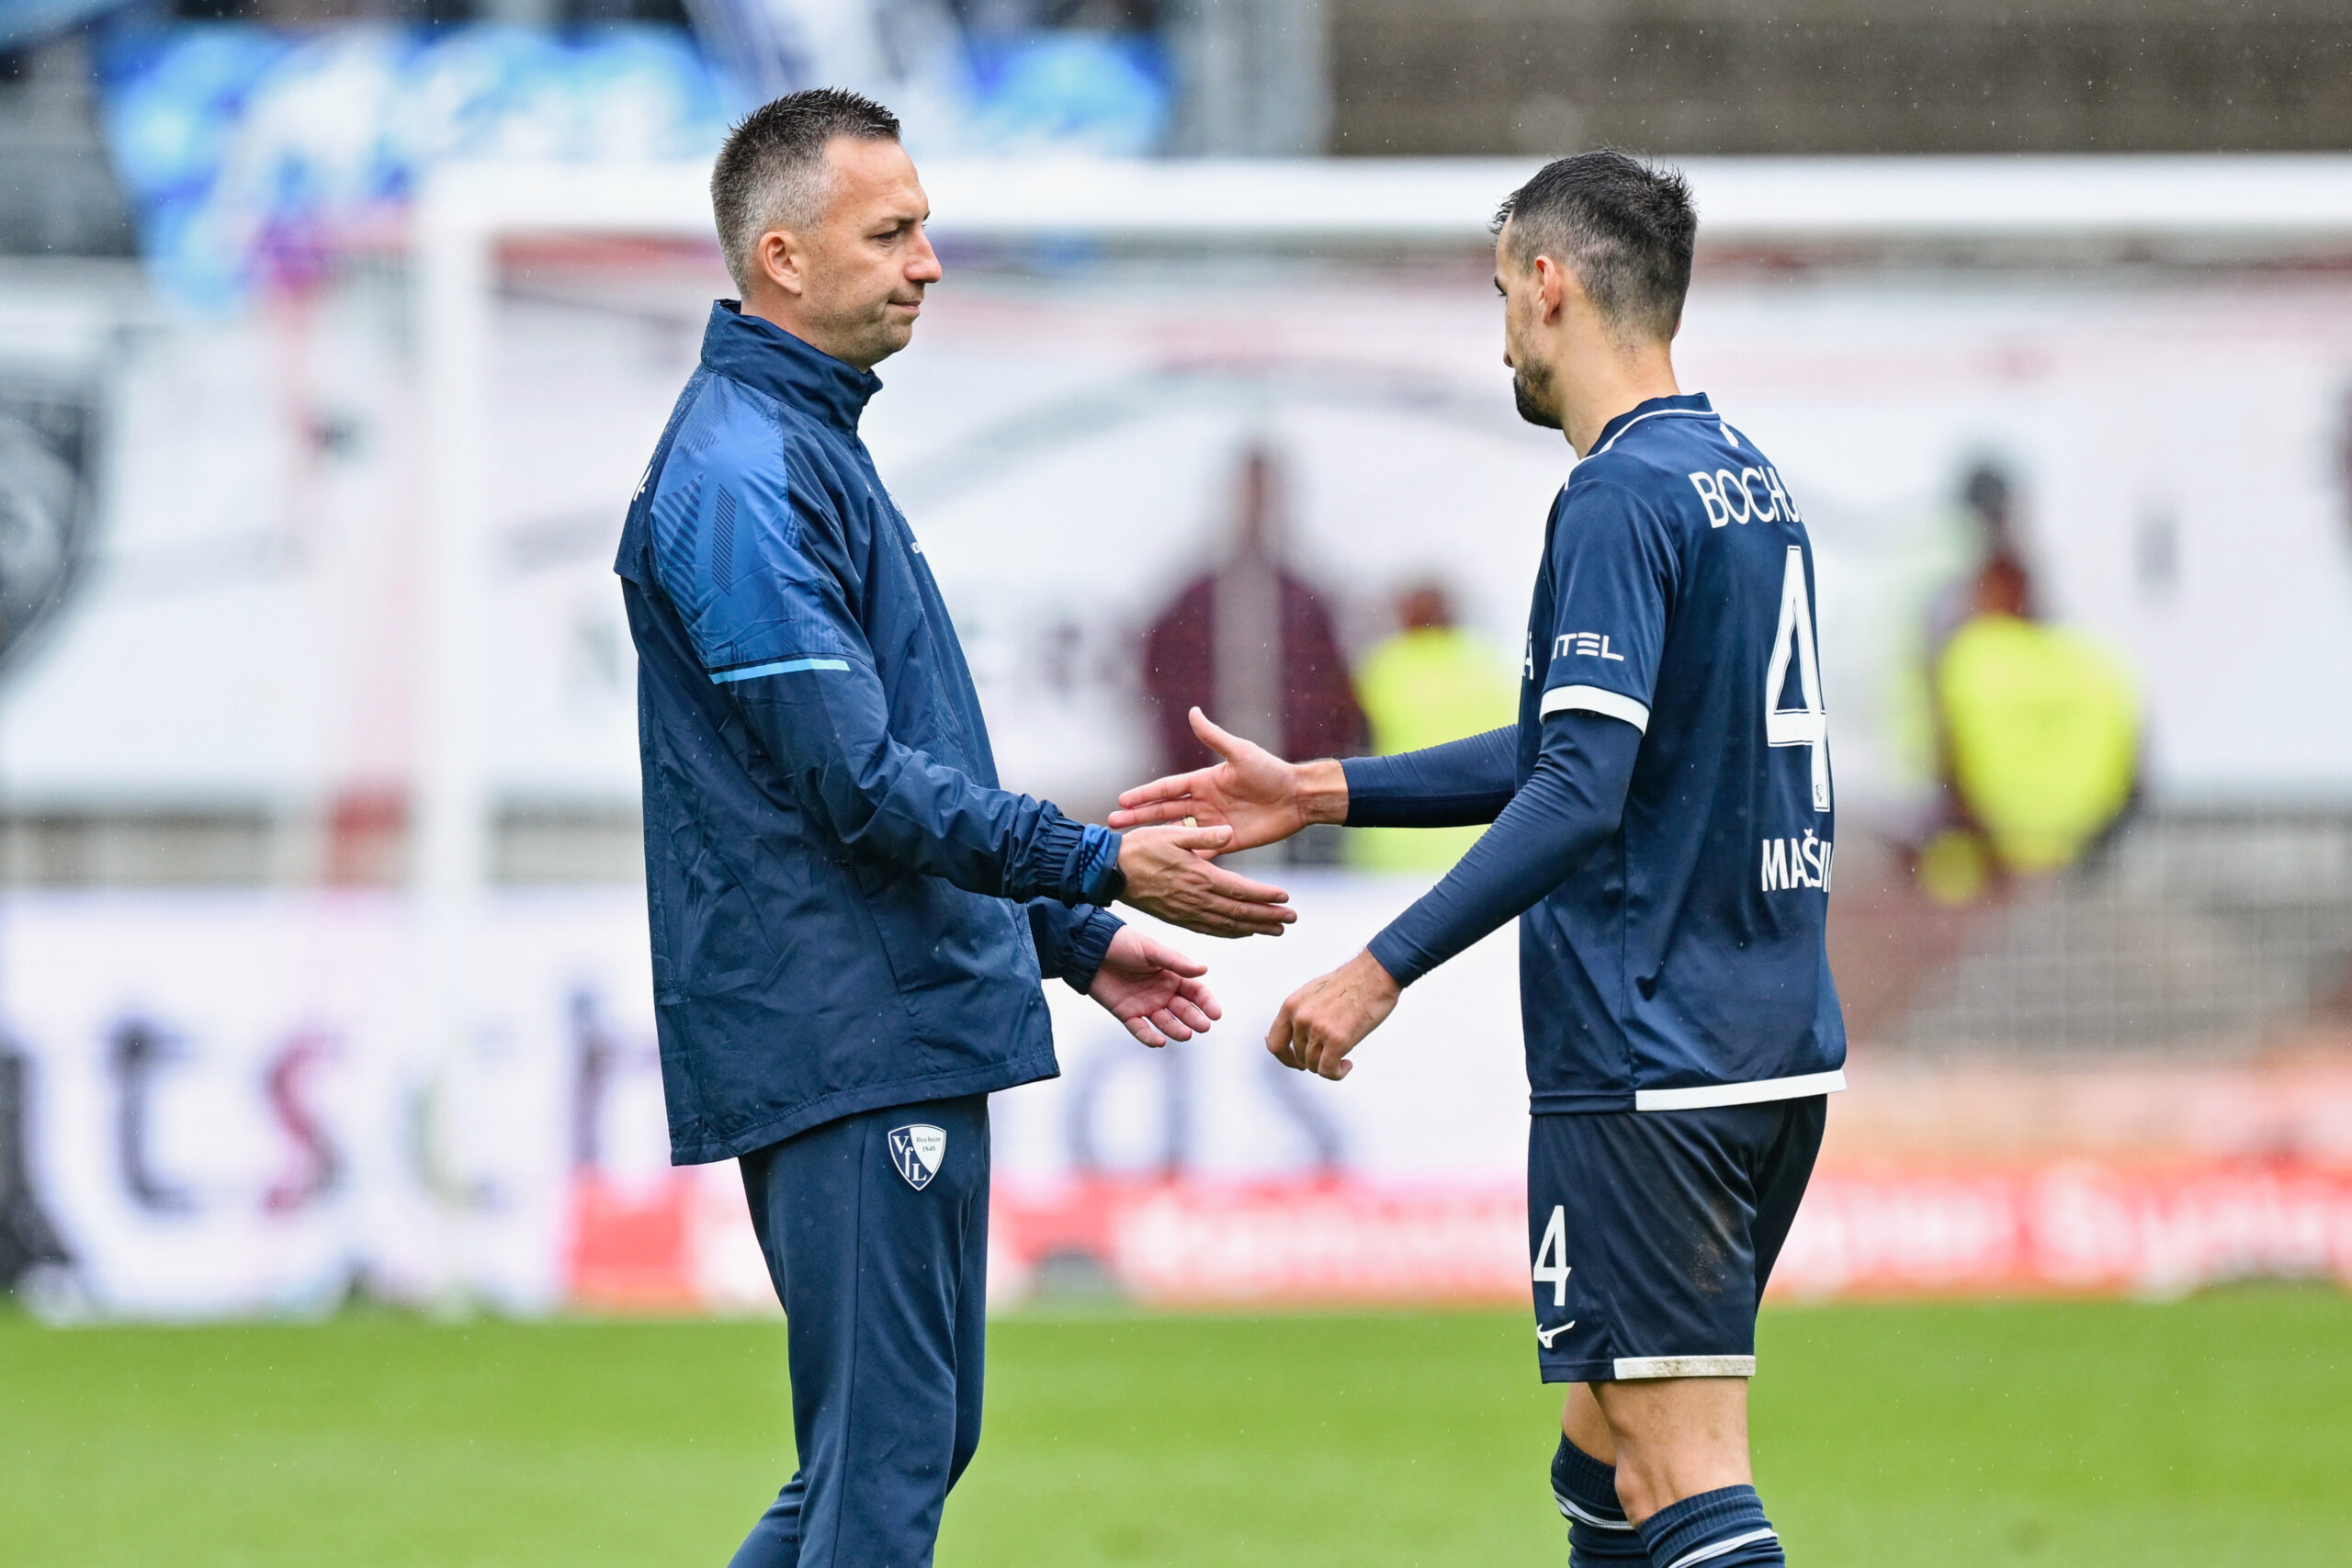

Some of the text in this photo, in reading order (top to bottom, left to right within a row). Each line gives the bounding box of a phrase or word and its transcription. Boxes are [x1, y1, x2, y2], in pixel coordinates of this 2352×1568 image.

[1688, 466, 1801, 529] BOCHU
[1765, 545, 1831, 813] 4
[891, 1135, 928, 1181] VfL
[1532, 1205, 1573, 1306] 4
